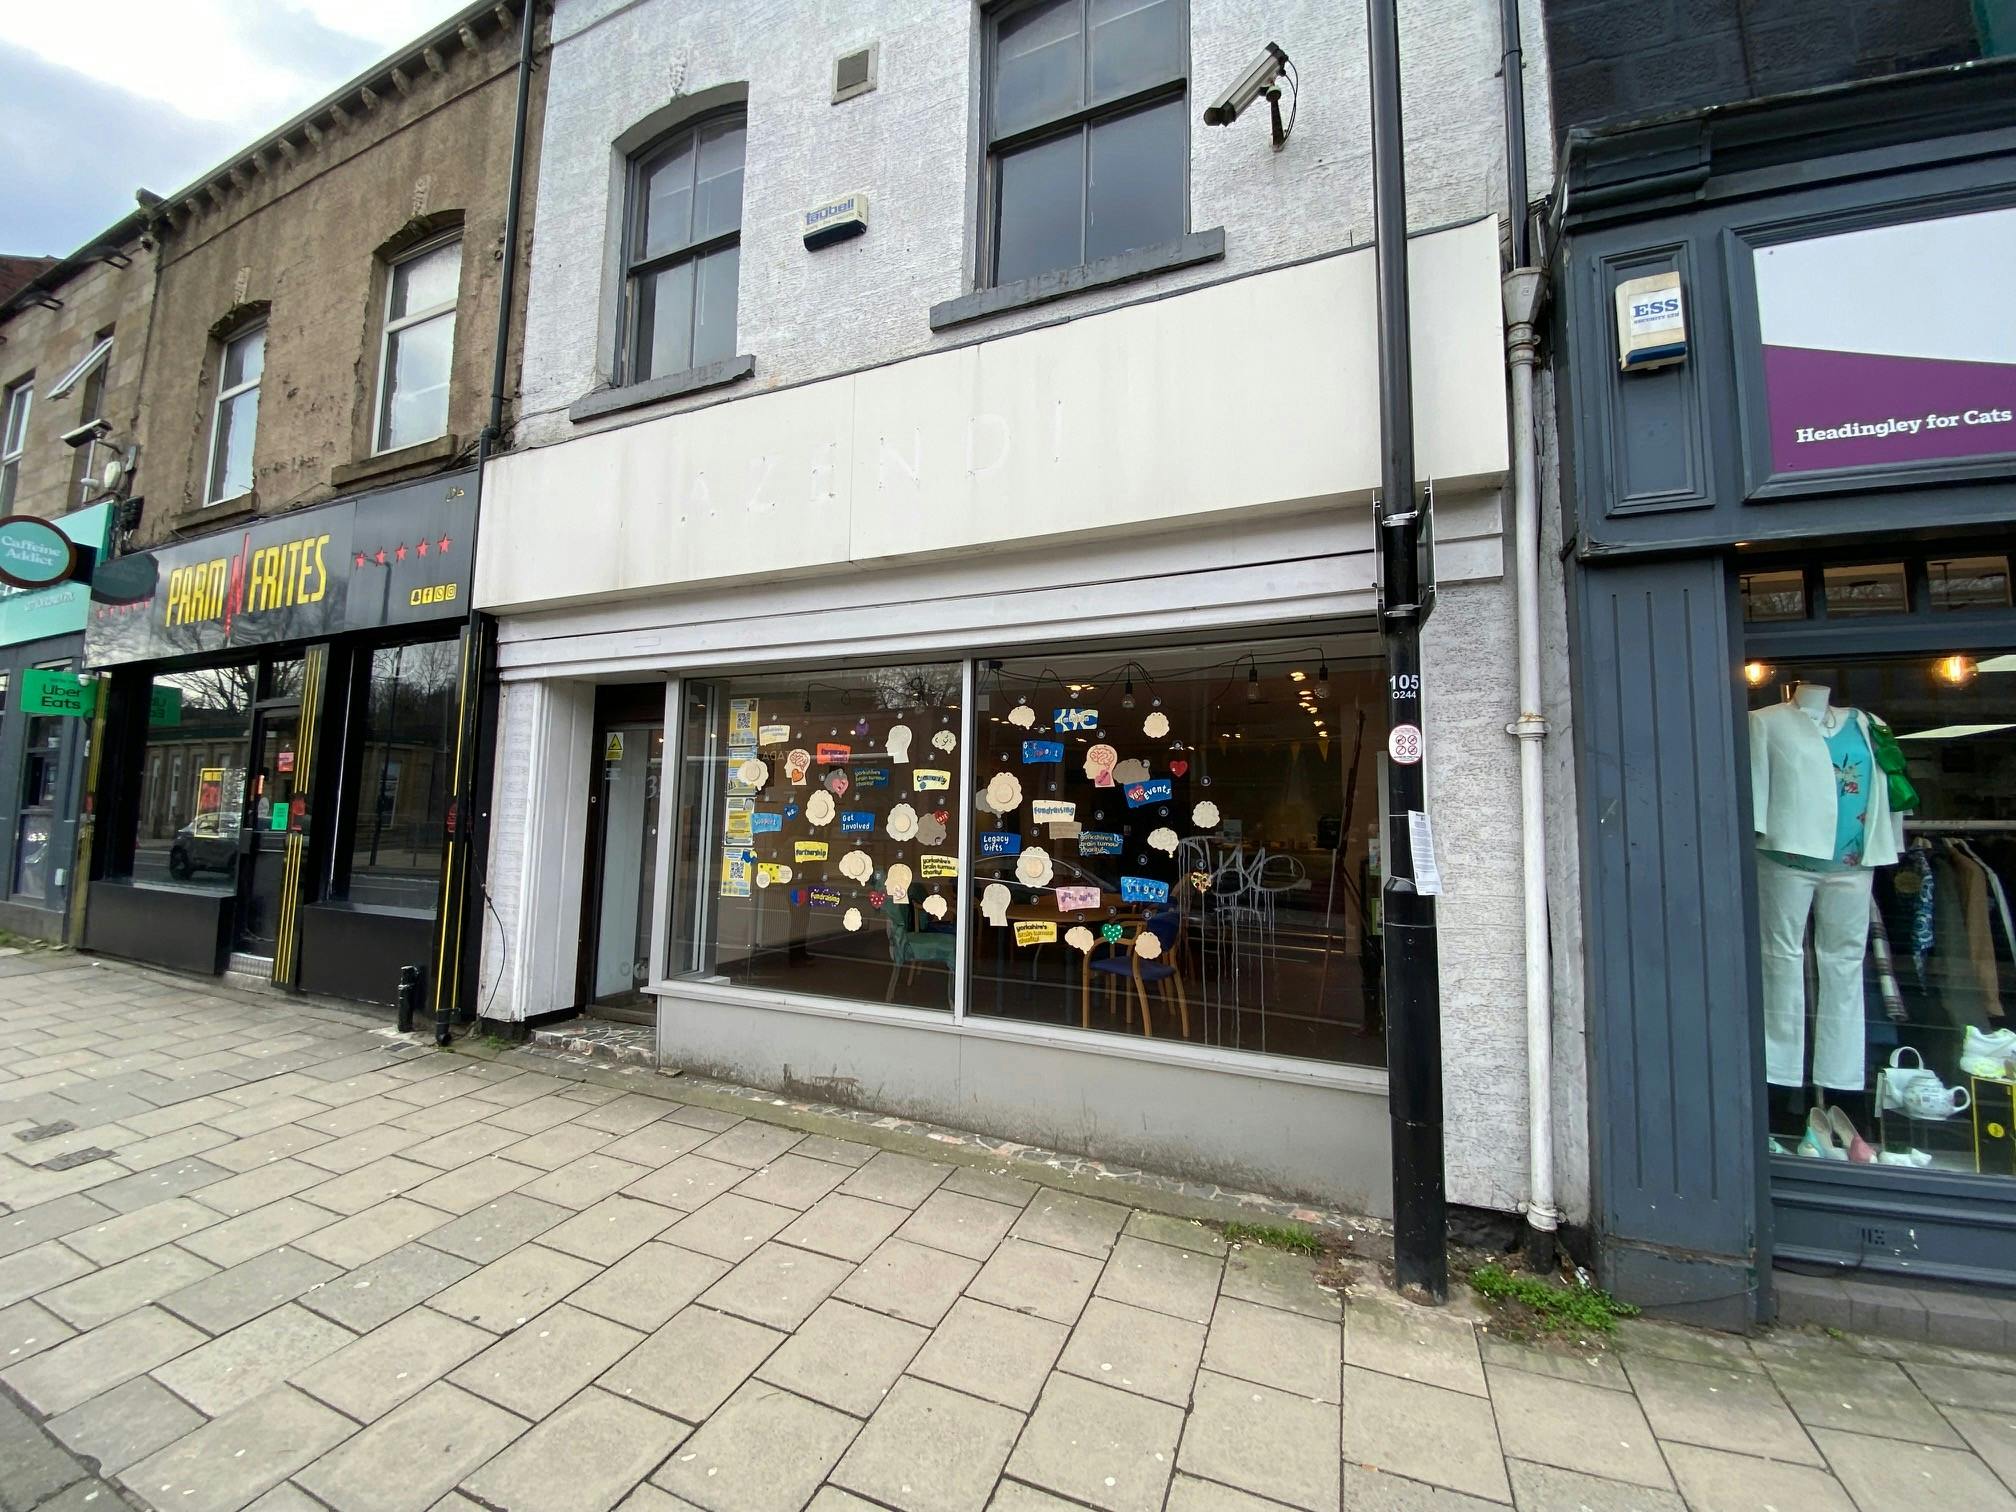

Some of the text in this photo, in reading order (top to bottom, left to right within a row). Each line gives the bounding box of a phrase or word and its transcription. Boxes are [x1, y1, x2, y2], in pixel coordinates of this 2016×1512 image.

[1632, 298, 1679, 318] ESS
[1796, 408, 2013, 443] Headingley for Cats
[2, 535, 61, 557] Caffeine
[5, 548, 54, 566] Addict
[165, 558, 228, 628] PARM
[247, 534, 331, 613] FRITES
[43, 684, 82, 697] Uber
[1389, 674, 1419, 690] 105
[41, 696, 81, 709] Eats
[1143, 784, 1172, 801] Events
[983, 835, 1009, 845] Legacy
[983, 843, 1003, 852] Gifts
